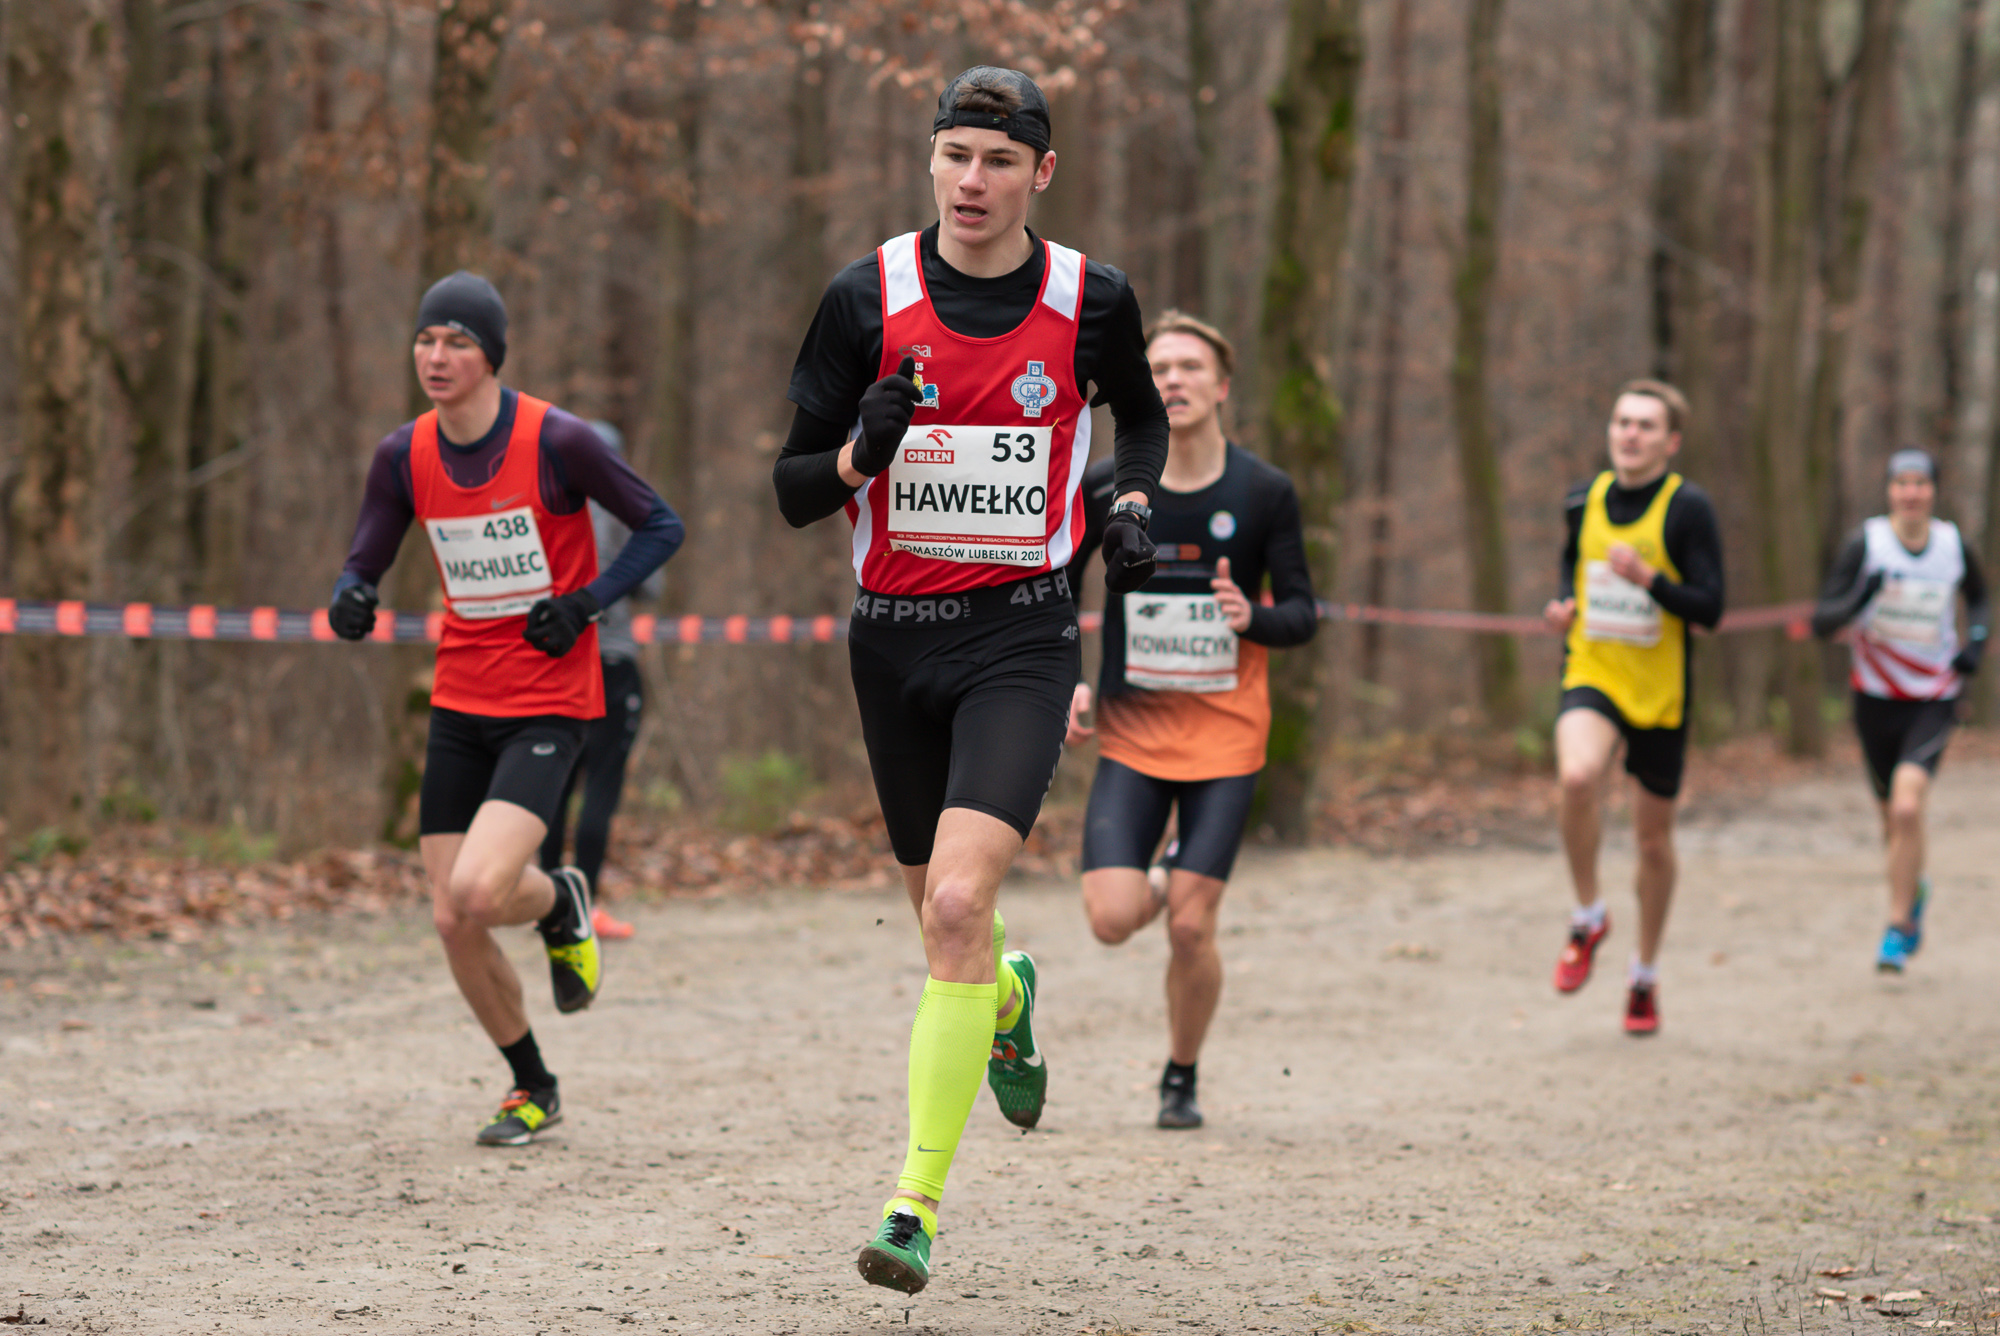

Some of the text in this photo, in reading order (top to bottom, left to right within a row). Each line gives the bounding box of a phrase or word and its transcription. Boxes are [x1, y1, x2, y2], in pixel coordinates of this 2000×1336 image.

[1025, 409, 1040, 417] 1956
[906, 450, 952, 463] ORLEN
[991, 432, 1036, 463] 53
[895, 482, 1046, 516] HAWEŁKO
[483, 515, 529, 541] 438
[445, 551, 543, 581] MACHULEC
[968, 549, 1017, 561] LUBELSKI
[1020, 550, 1043, 561] 2021
[1131, 634, 1234, 658] KOWALCZYK
